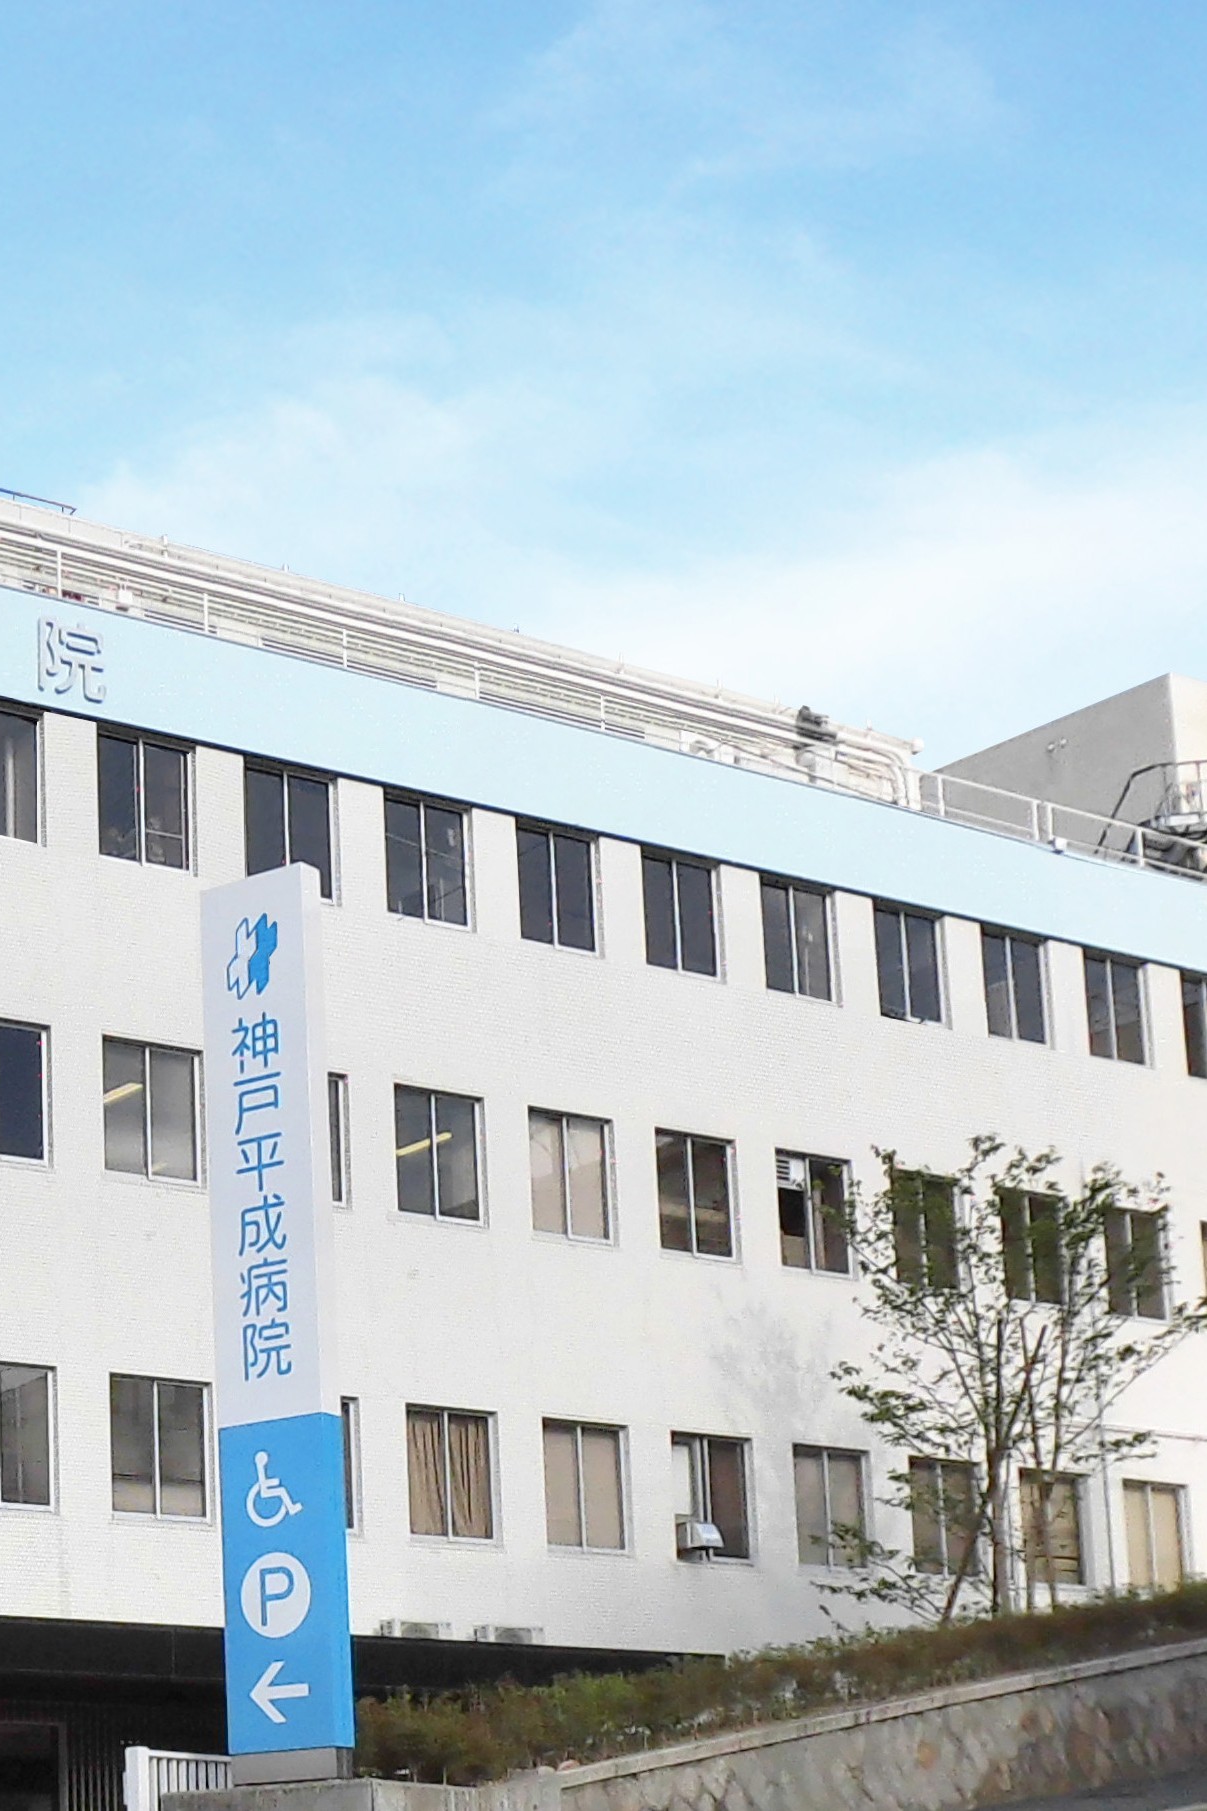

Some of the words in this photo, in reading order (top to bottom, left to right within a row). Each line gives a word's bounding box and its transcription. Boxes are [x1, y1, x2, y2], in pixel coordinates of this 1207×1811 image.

[231, 1011, 293, 1382] 神戸平成病院
[258, 1566, 295, 1627] P
